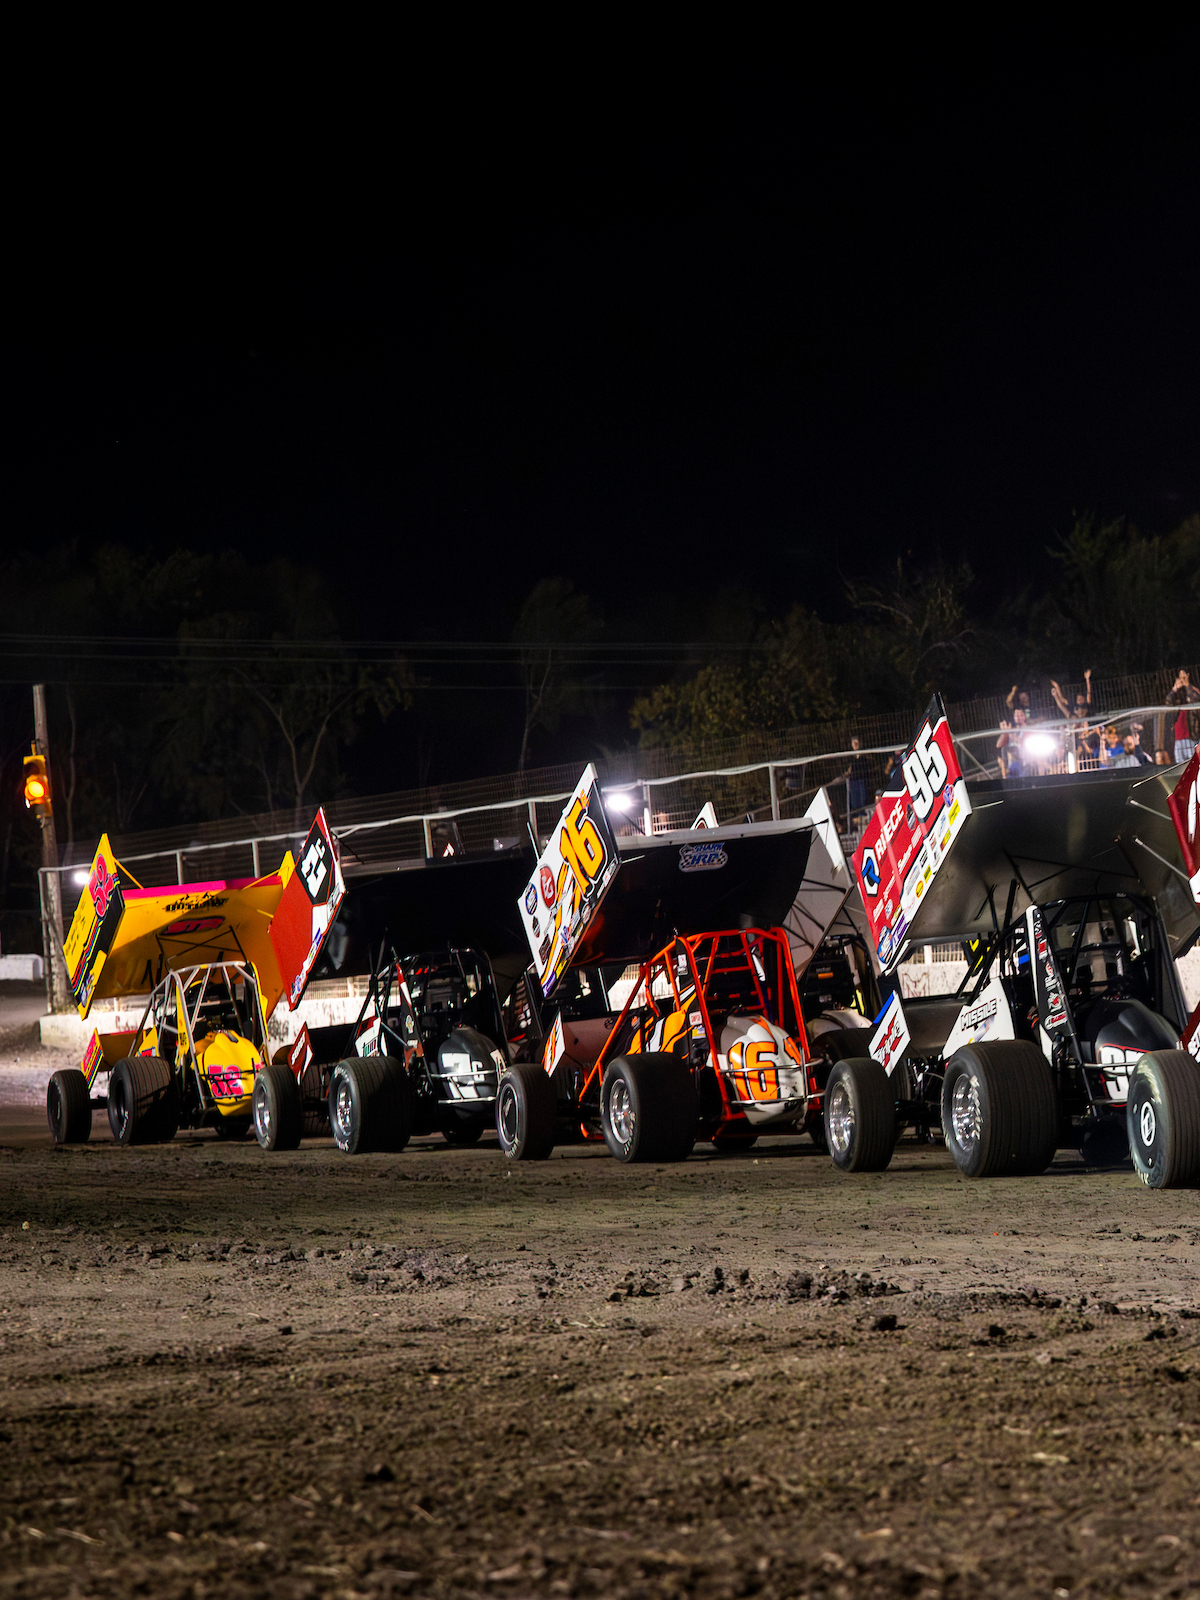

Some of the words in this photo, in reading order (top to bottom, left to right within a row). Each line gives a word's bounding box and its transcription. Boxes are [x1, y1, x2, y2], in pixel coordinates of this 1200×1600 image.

[902, 720, 948, 824] 95
[88, 854, 115, 917] 52
[961, 998, 997, 1032] MISSILE
[208, 1064, 243, 1098] 52
[727, 1041, 779, 1101] 16
